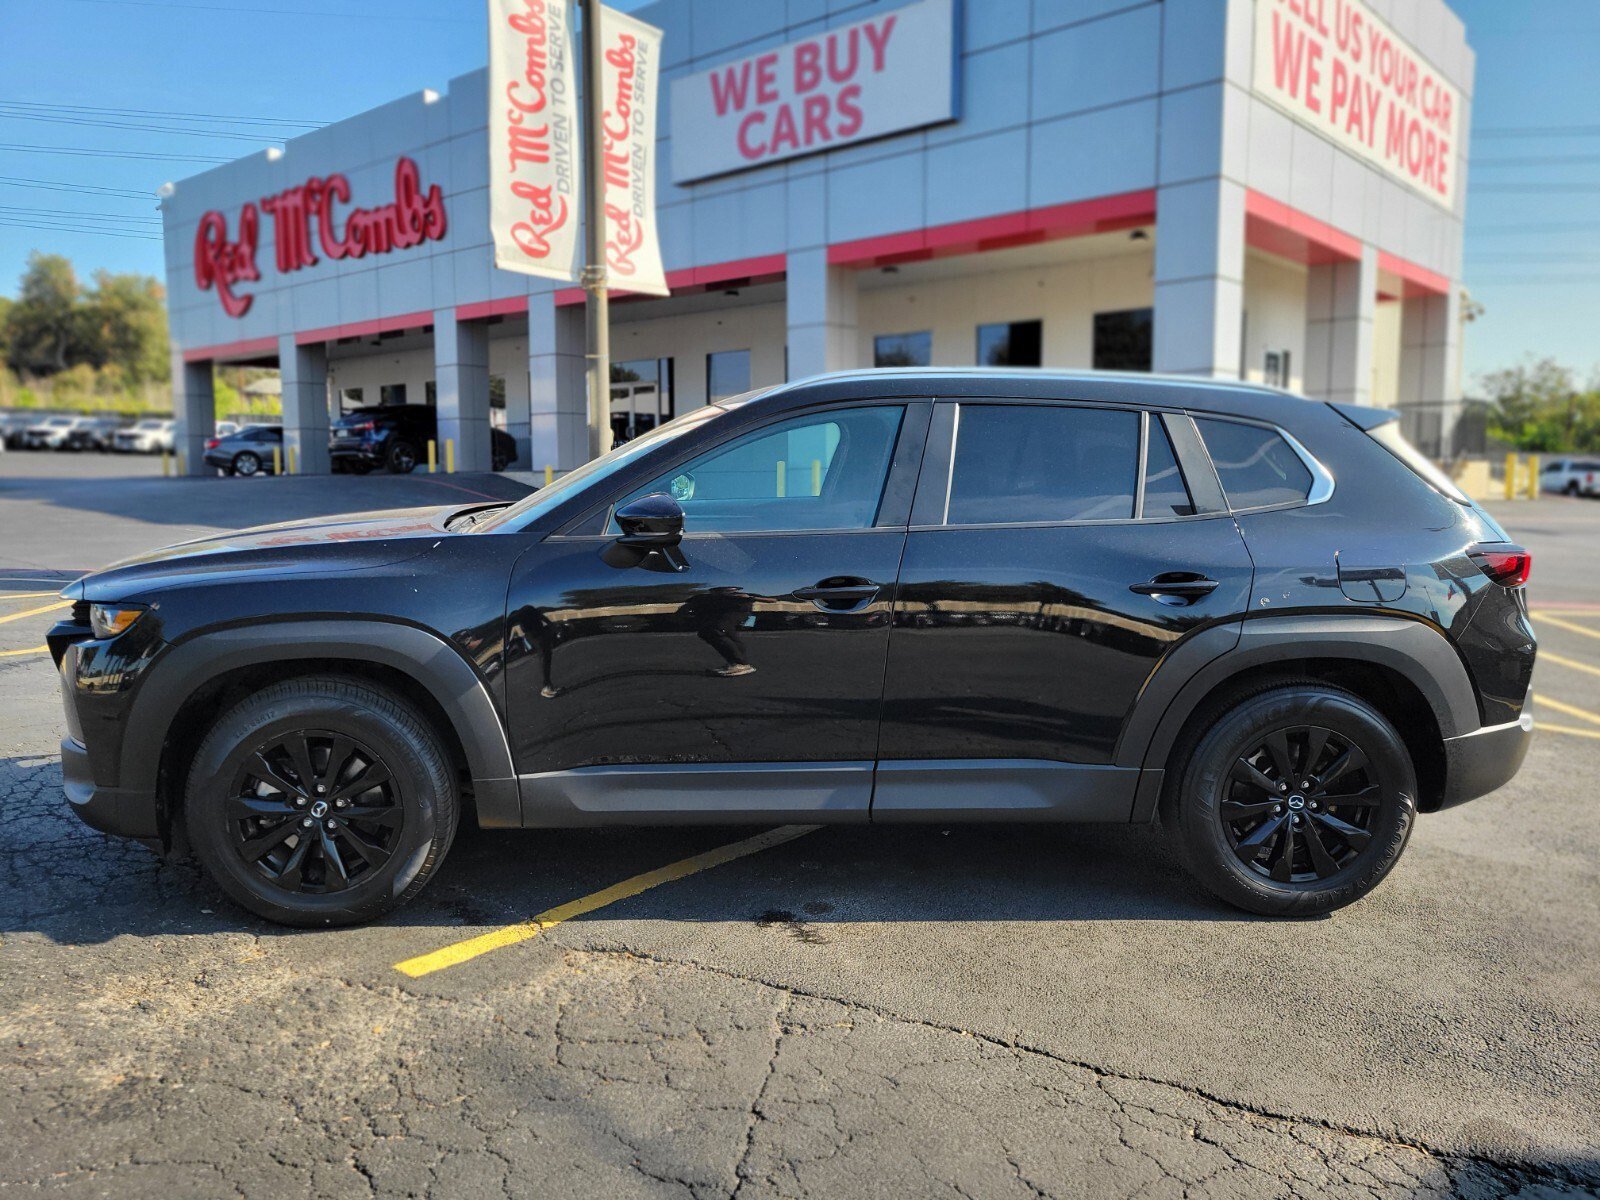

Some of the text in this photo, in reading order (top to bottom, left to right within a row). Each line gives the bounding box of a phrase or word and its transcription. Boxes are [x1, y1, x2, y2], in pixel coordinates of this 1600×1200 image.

[548, 4, 570, 195] DRIVEN TO SERVE
[631, 39, 649, 218] DRIVEN TO SERVE
[709, 15, 898, 118] WE BUY
[736, 84, 863, 161] CARS
[1272, 9, 1449, 195] WE PAY MORE
[1335, 0, 1363, 63] US
[1367, 23, 1419, 108] YOUR
[1421, 75, 1453, 136] CAR
[193, 156, 447, 318] Red McCombs
[510, 181, 568, 259] Red
[605, 203, 644, 276] Red
